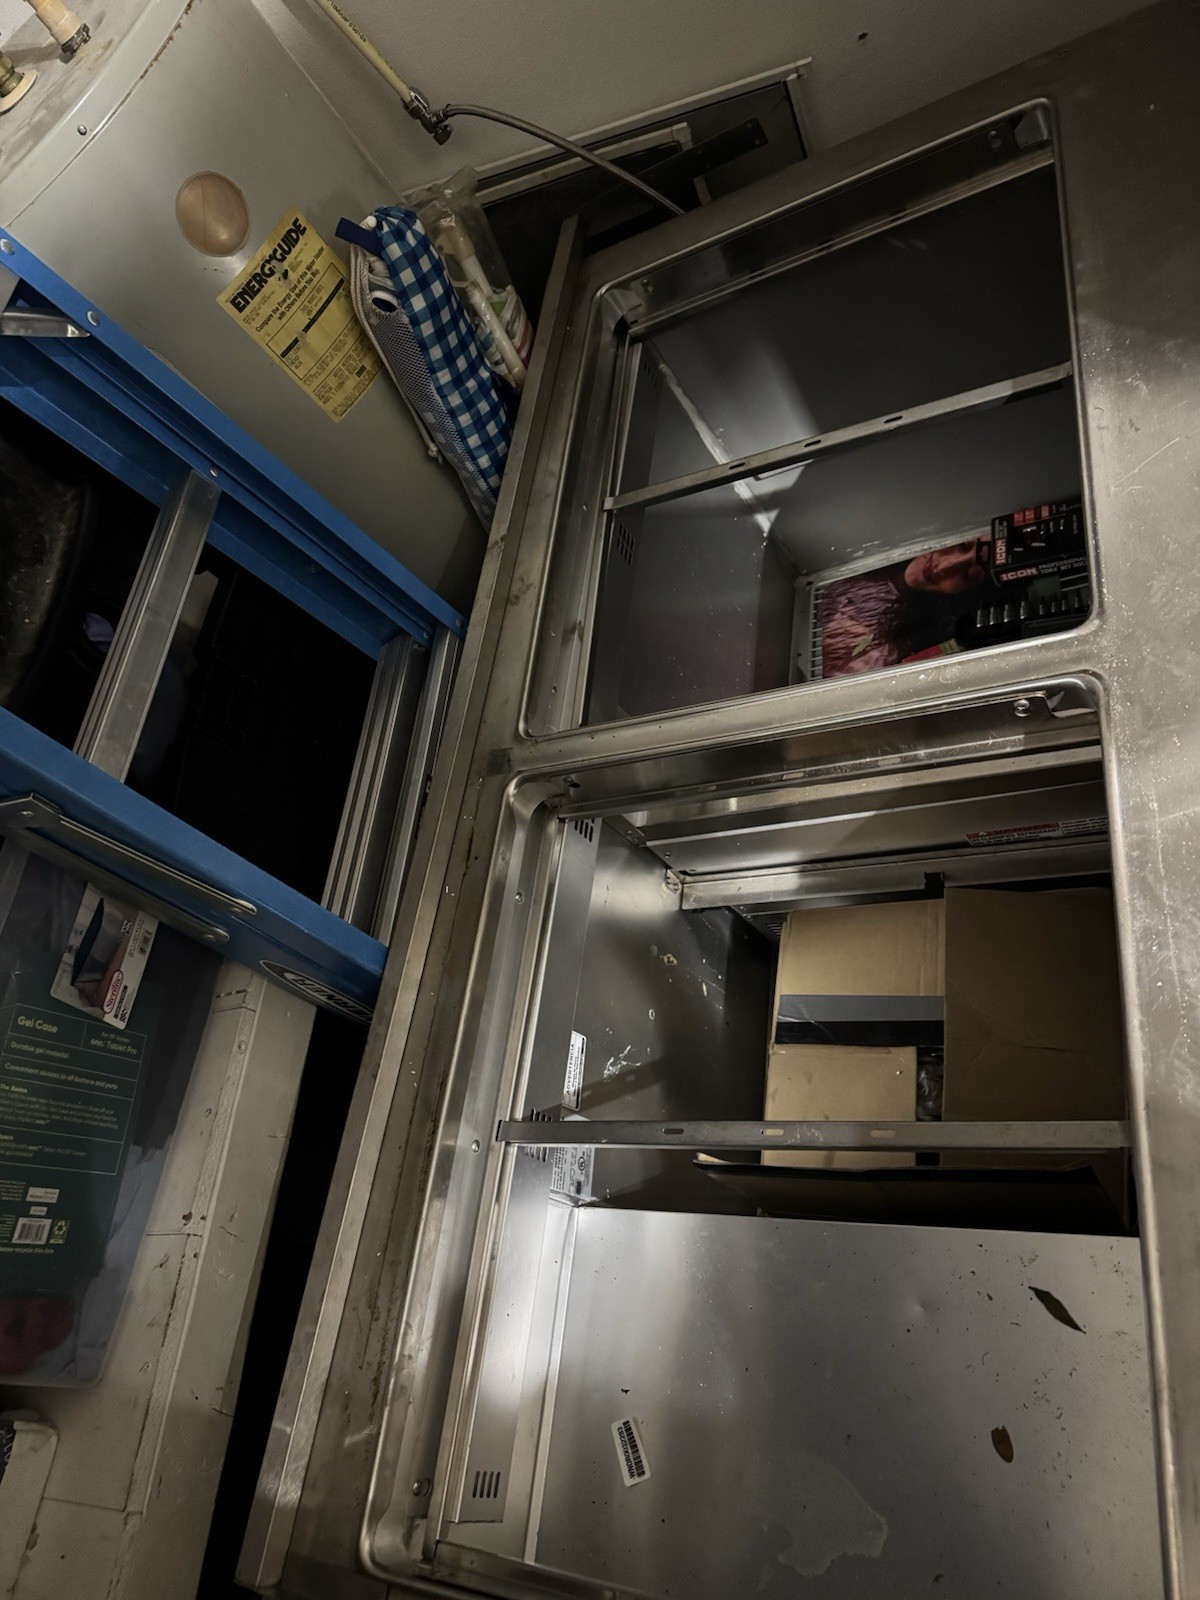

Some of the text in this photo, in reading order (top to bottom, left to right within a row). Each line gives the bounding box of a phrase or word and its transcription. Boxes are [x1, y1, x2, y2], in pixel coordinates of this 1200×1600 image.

[255, 311, 275, 334] Compare
[270, 304, 280, 315] the
[277, 291, 293, 308] Energy
[288, 282, 298, 293] Use
[294, 276, 302, 284] of
[298, 269, 308, 280] this
[304, 258, 317, 272] Water
[312, 245, 326, 260] Heater
[276, 310, 287, 321] with
[283, 296, 297, 312] Others
[294, 283, 308, 299] Before
[304, 275, 314, 285] You
[1000, 566, 1039, 582] ICON
[105, 976, 122, 1008] Sterilite
[16, 1014, 59, 1033] Gel Case
[10, 1041, 69, 1058] Durable gel material
[106, 1040, 127, 1052] Tablet
[126, 1045, 138, 1055] Pro
[4, 1062, 39, 1074] Convenient
[39, 1070, 59, 1078] access
[74, 1076, 94, 1084] buttons
[104, 1082, 118, 1090] ports
[566, 1043, 575, 1093] ADVERTENCIA
